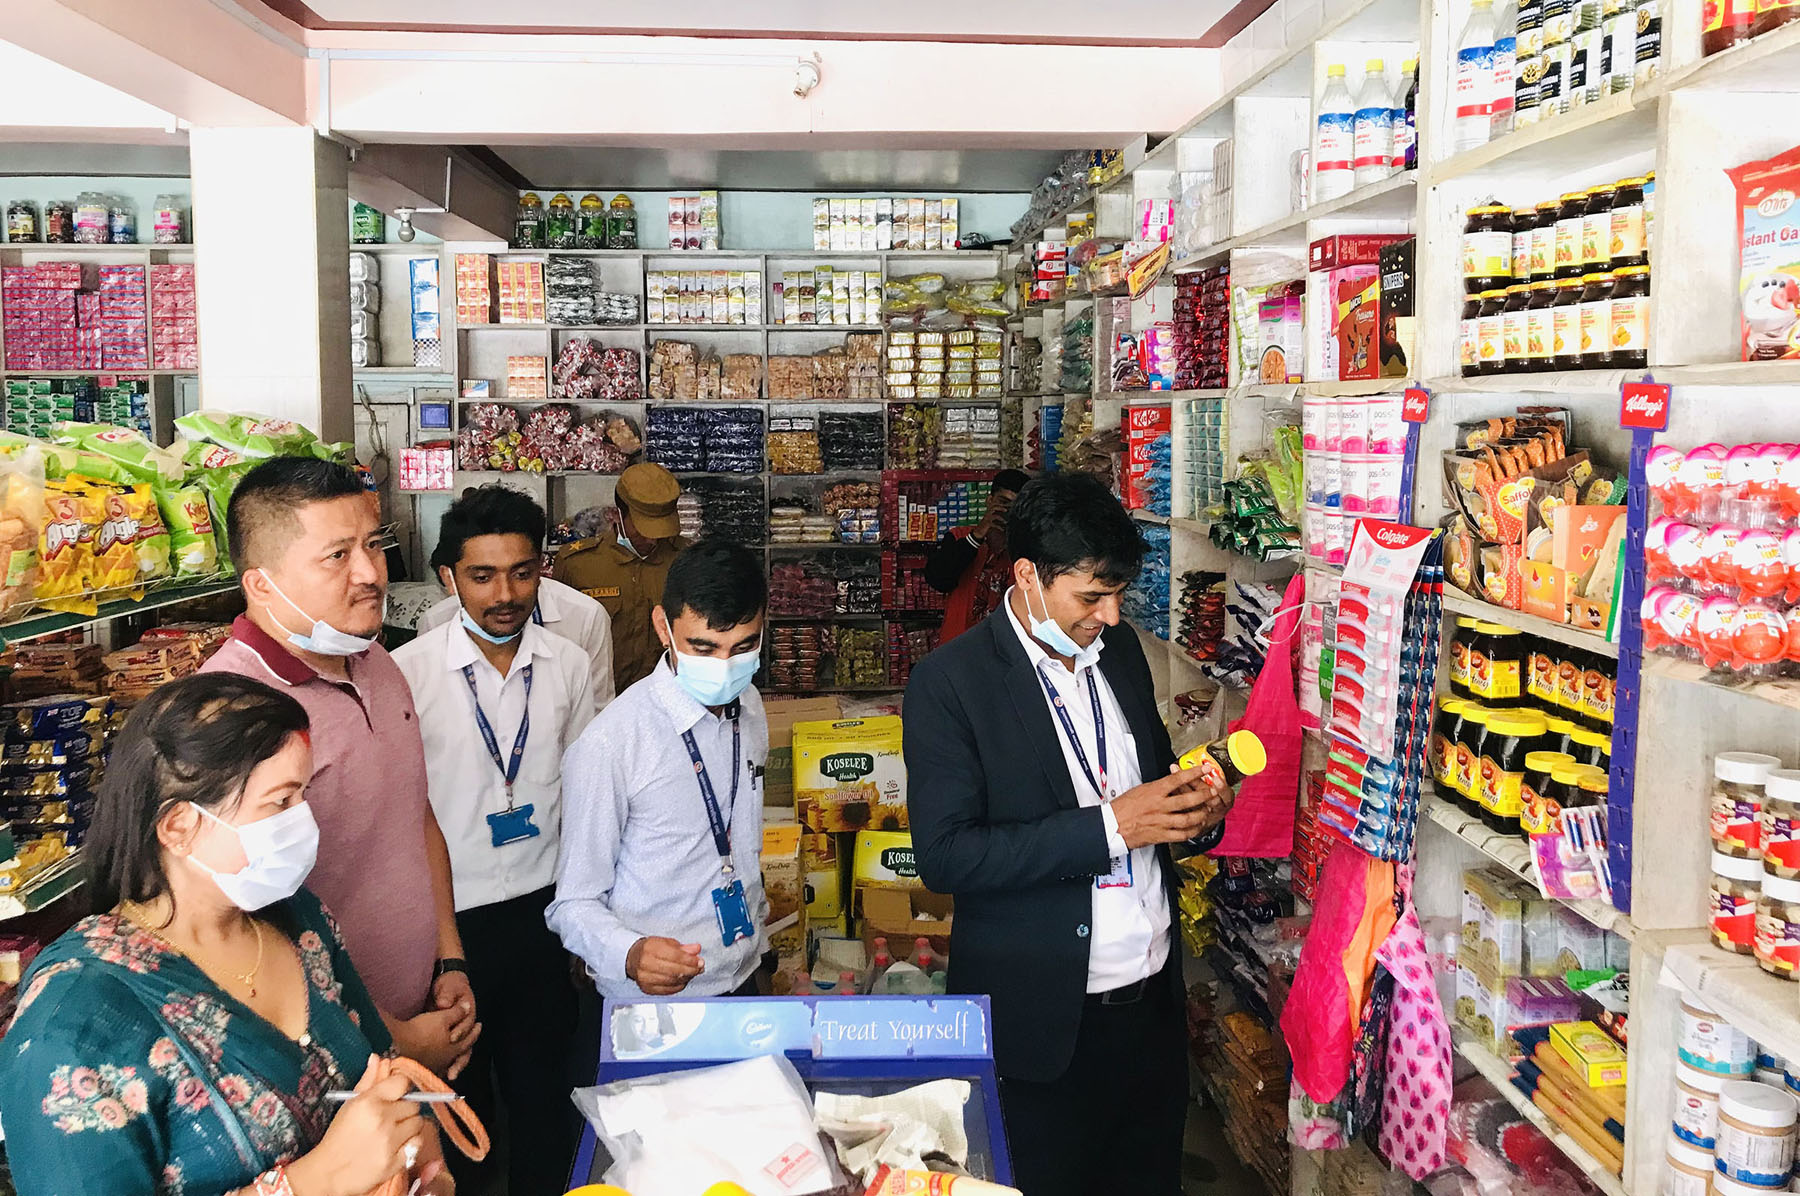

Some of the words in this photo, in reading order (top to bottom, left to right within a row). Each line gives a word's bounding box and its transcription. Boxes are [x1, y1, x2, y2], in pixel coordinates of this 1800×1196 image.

[1743, 229, 1776, 248] stant
[1780, 225, 1800, 242] Oa
[1383, 273, 1404, 289] SNIPERS
[1625, 393, 1664, 417] Kellogg's
[1135, 409, 1159, 426] KitKat
[1503, 489, 1533, 505] Saffol
[59, 499, 74, 520] 3
[110, 498, 124, 517] 3
[100, 517, 139, 545] Angle
[1376, 527, 1411, 546] Colgate
[60, 705, 84, 718] TOP
[826, 757, 868, 773] KOSELEE
[888, 851, 916, 866] KOSEL
[820, 1020, 880, 1041] Treat
[888, 1010, 970, 1048] Yourself
